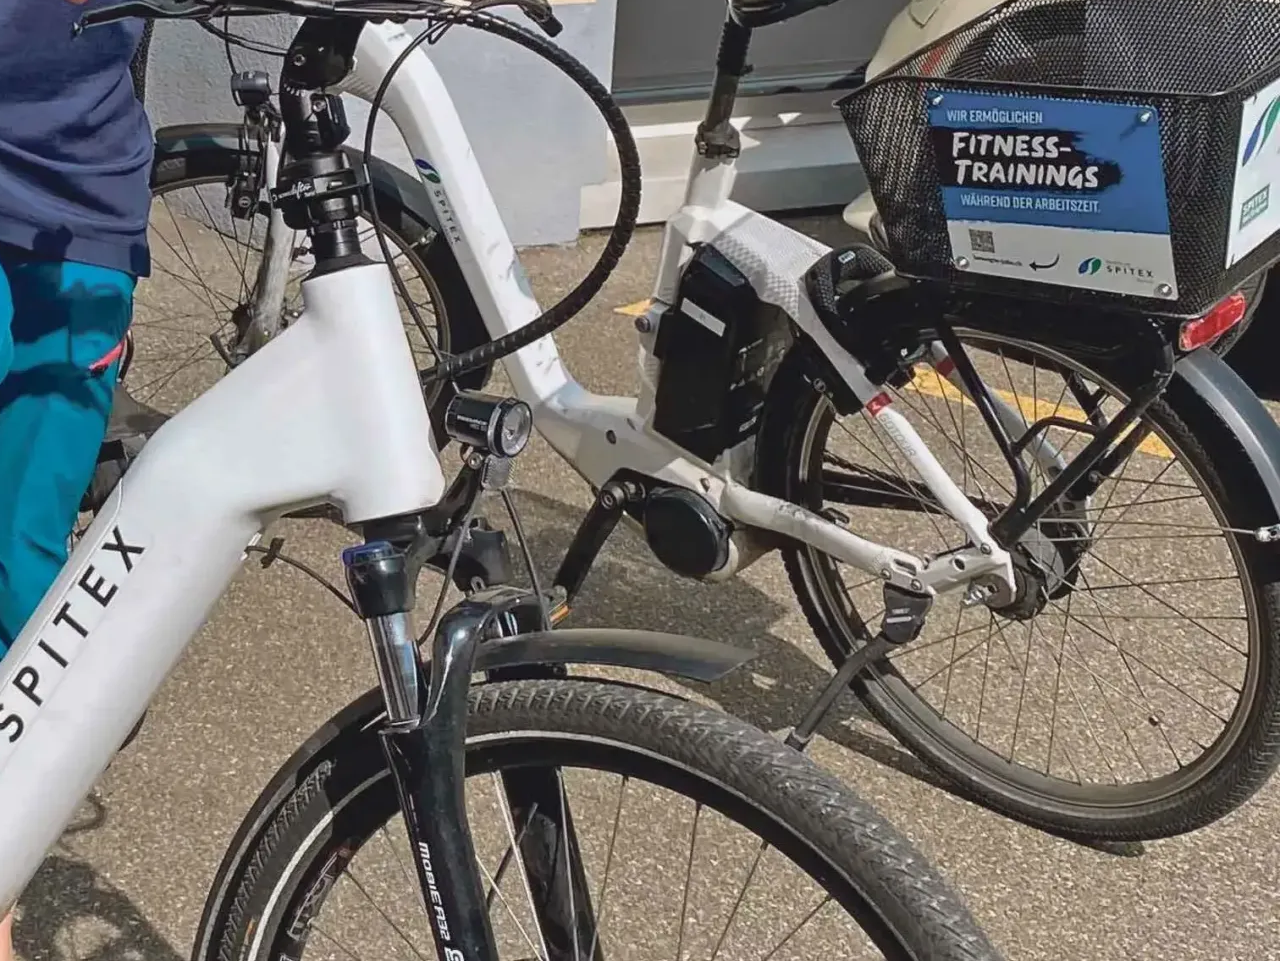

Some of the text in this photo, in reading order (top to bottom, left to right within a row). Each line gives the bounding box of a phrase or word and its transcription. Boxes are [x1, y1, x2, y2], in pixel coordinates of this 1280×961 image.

[946, 107, 1043, 124] WIR ERMÖGLICHEN
[952, 131, 1072, 159] FITNESS-
[954, 159, 1099, 189] TRAININGS
[960, 193, 1011, 209] WÄHREND
[1012, 196, 1033, 210] DER
[433, 189, 462, 244] SPITEX
[1106, 264, 1155, 279] SPITEX
[418, 841, 443, 906] MOBIE
